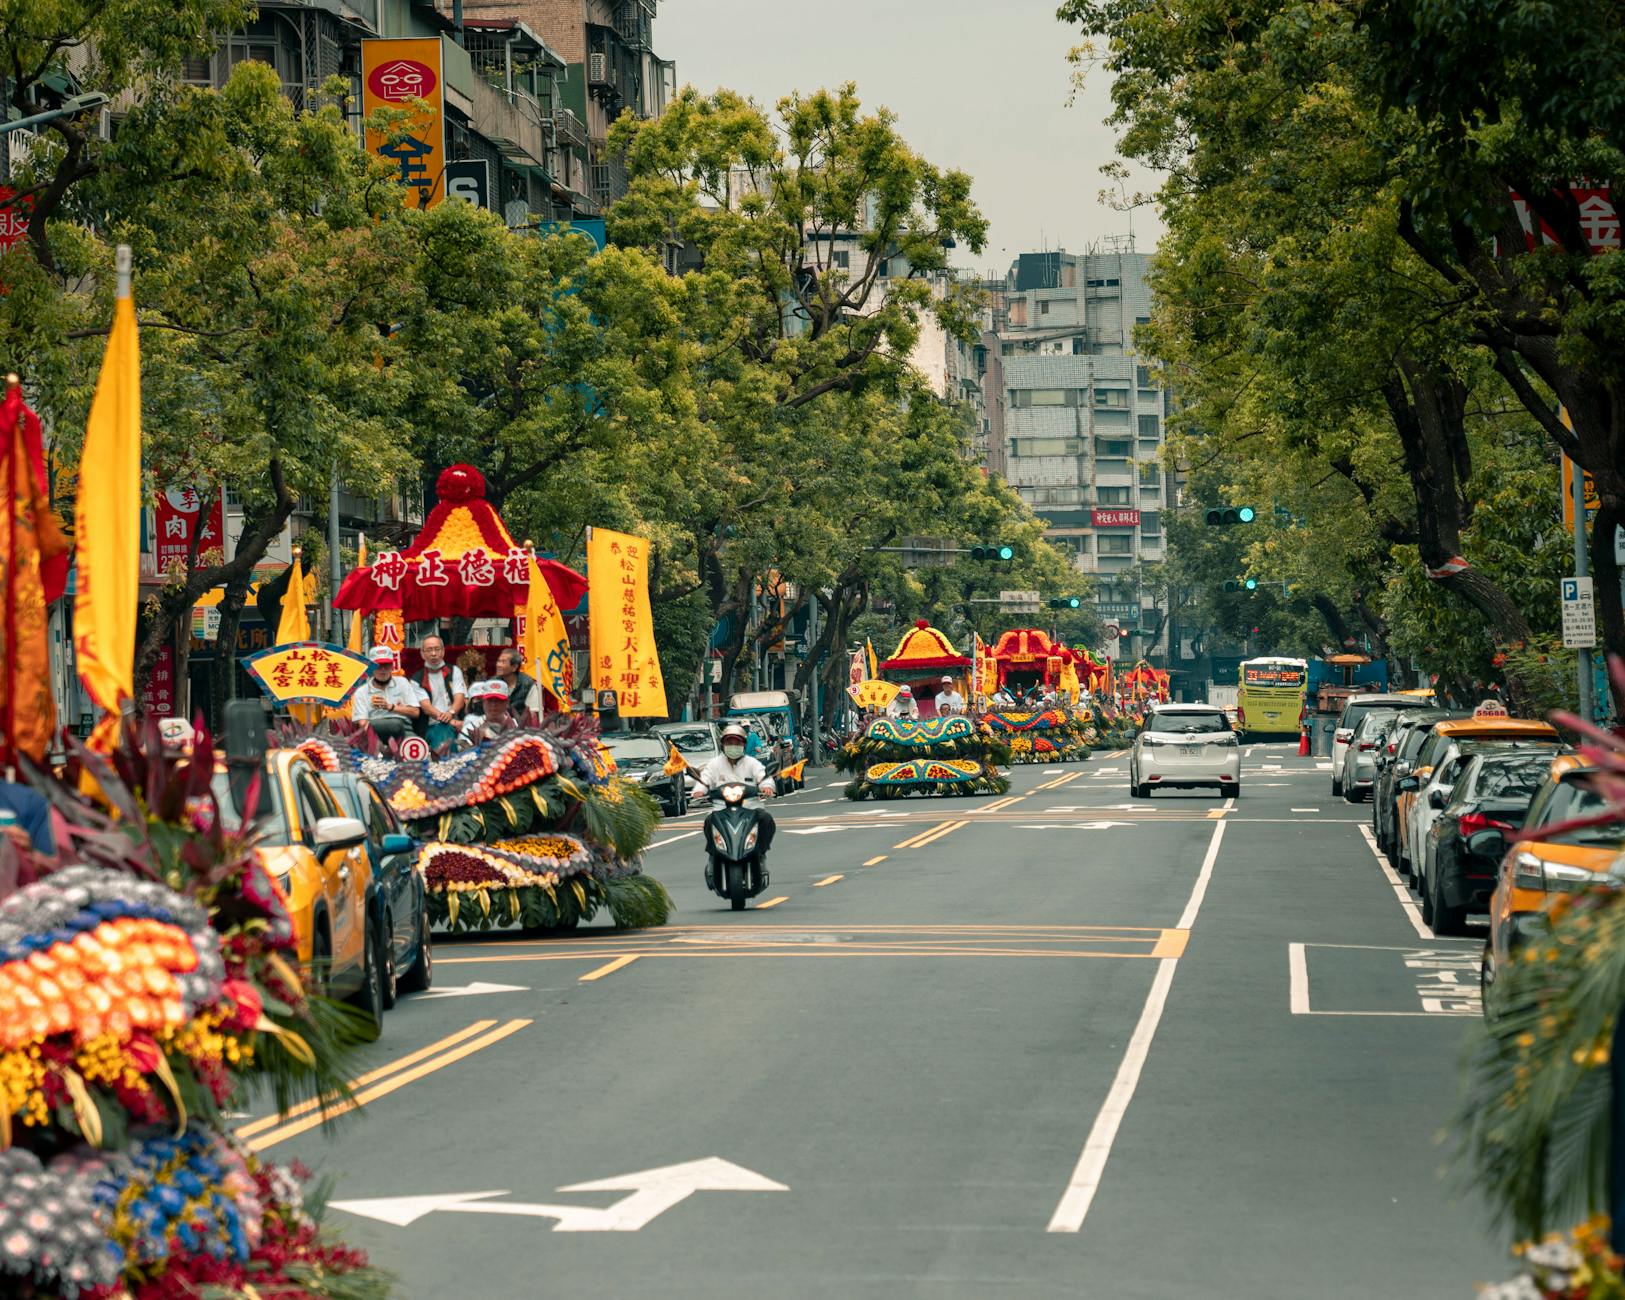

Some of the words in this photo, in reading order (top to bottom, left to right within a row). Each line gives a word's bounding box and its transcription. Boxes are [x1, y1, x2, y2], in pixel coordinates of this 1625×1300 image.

[165, 514, 216, 540] 肉
[610, 541, 640, 560] 恭迎
[1565, 583, 1576, 599] P
[408, 744, 420, 759] 8
